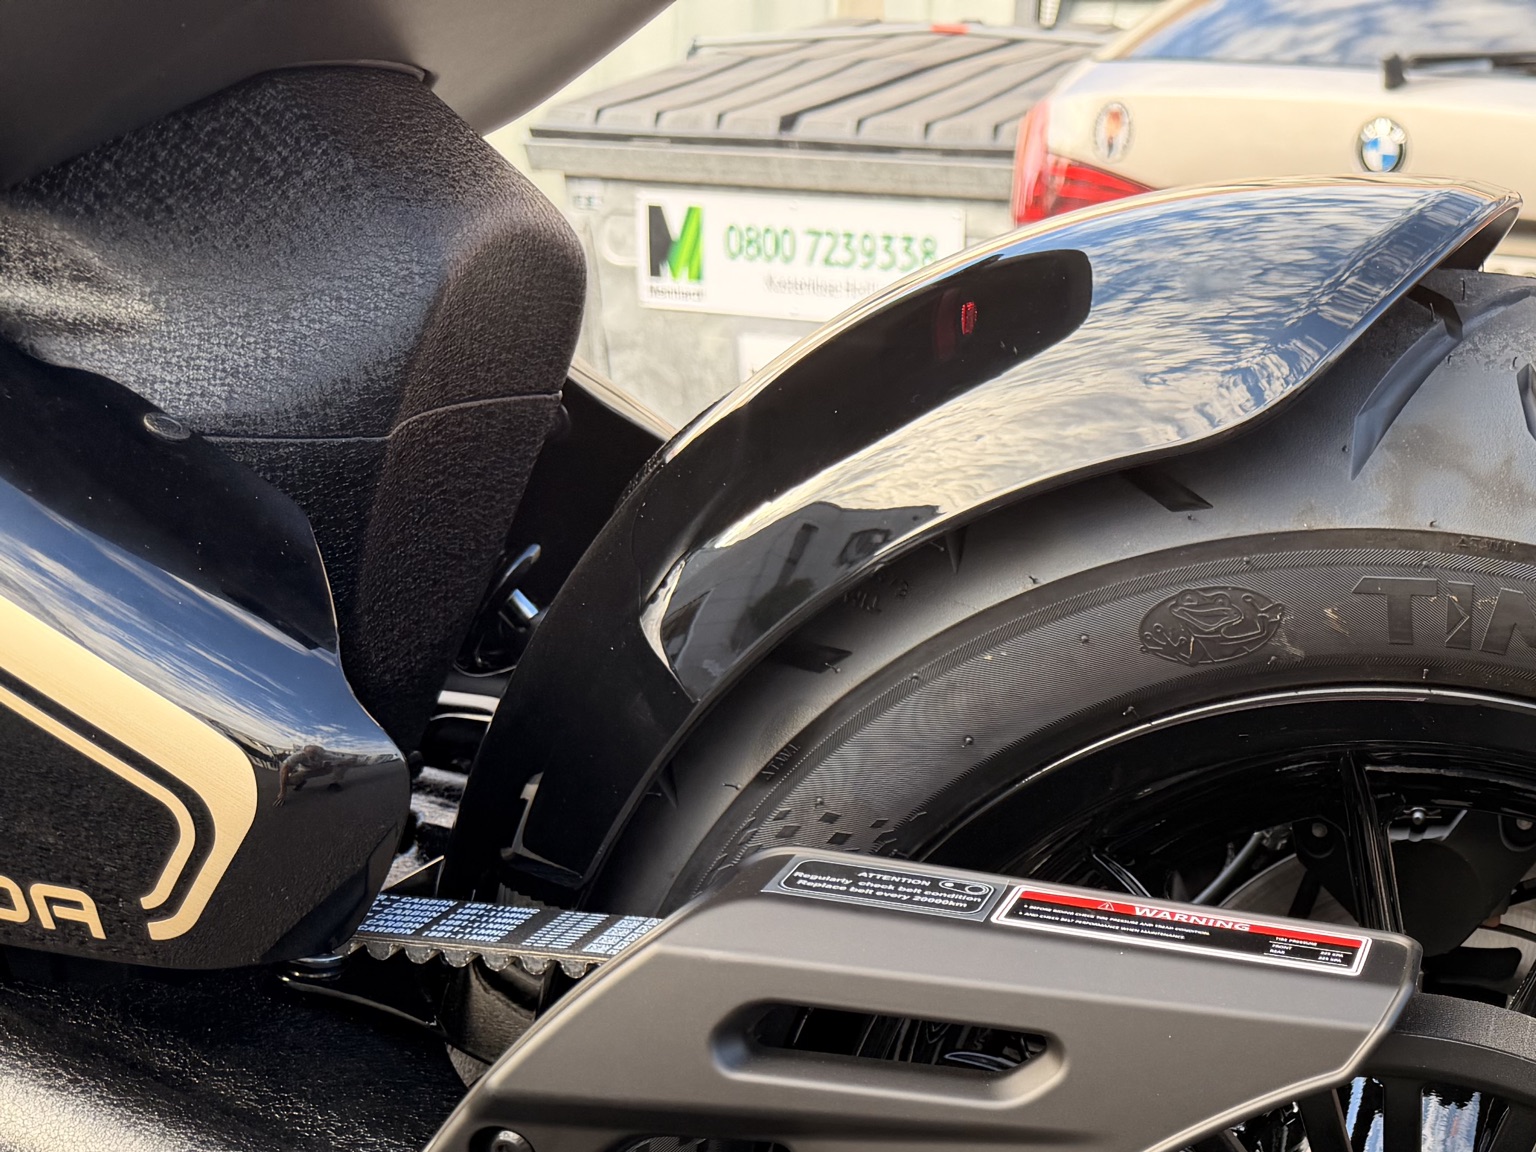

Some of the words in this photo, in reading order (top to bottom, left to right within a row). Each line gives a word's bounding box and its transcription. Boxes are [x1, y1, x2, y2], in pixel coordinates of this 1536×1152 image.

[724, 225, 796, 263] 0800
[804, 230, 938, 272] 7239338
[857, 871, 931, 887] ATTENTION
[793, 871, 853, 885] Regularly
[858, 881, 896, 891] check
[897, 884, 923, 894] belt
[923, 889, 982, 903] condition
[796, 879, 847, 891] Replace
[849, 886, 875, 895] belt
[875, 890, 911, 901] every
[912, 895, 968, 908] 20000km
[392, 902, 450, 912] CARBON
[401, 896, 458, 907] CARBON
[383, 907, 442, 918] CARBON
[1133, 905, 1251, 931] WARNING
[365, 919, 425, 929] CARBON
[374, 913, 433, 924] CARBON
[357, 925, 416, 935] CARBON
